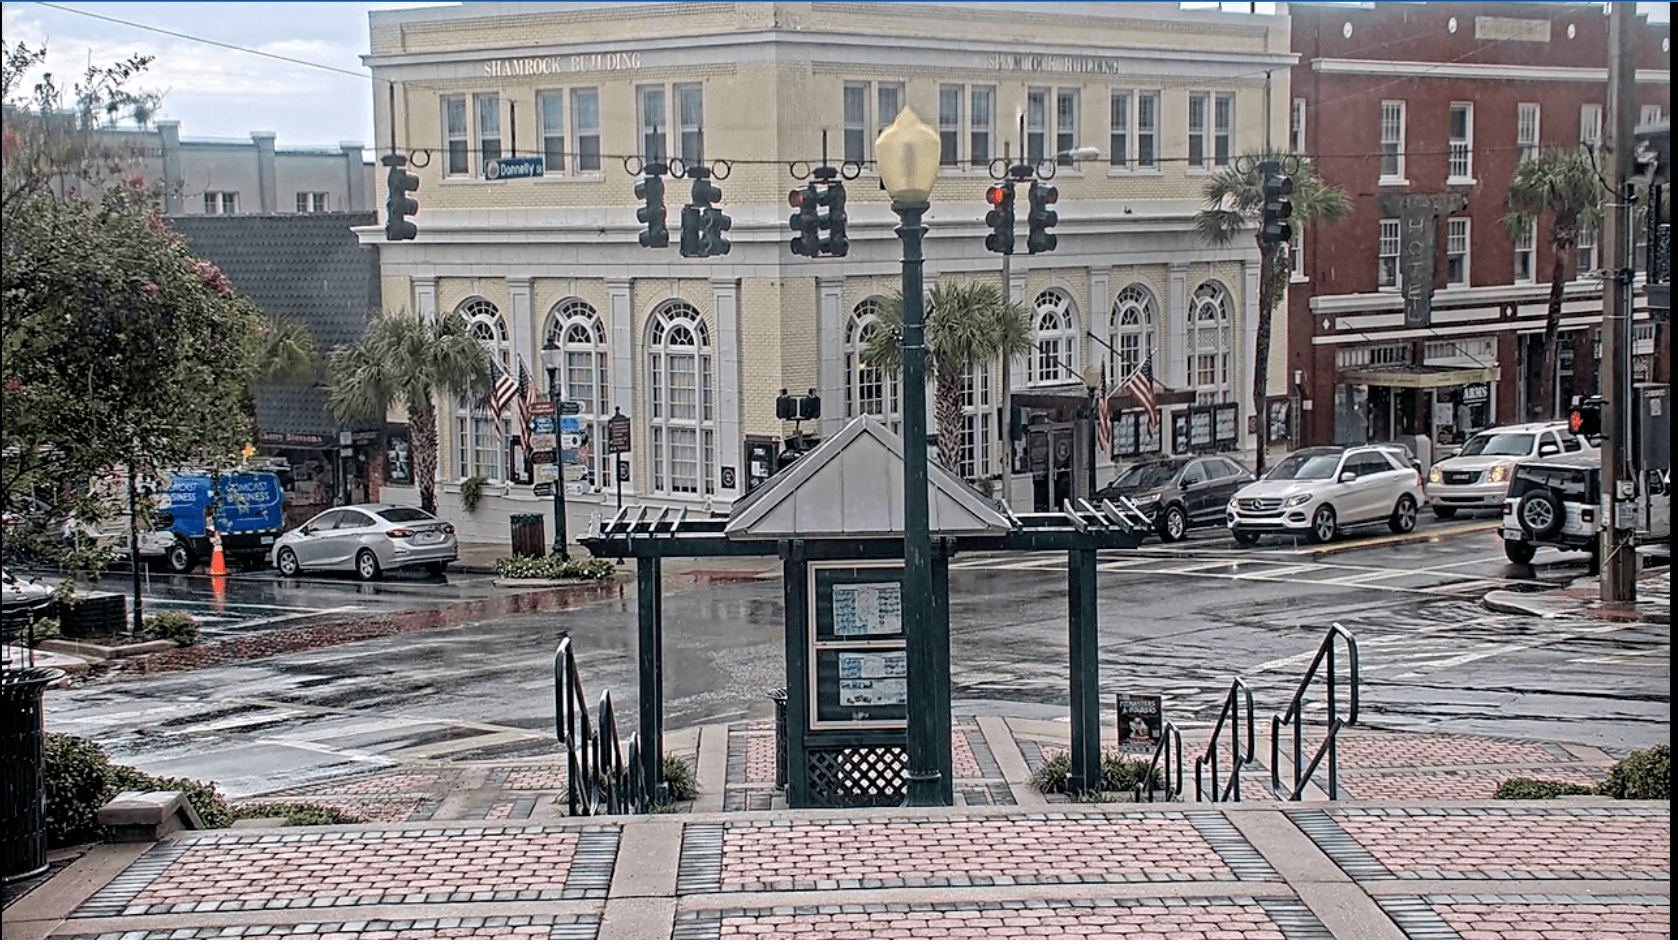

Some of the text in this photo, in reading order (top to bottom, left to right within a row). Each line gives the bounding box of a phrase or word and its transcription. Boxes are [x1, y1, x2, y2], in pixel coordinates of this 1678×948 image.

[485, 53, 641, 77] SHAMROCK BUILDING
[986, 54, 1120, 75] SHAMROCK BUILDING
[500, 161, 535, 178] Donnelly
[1462, 386, 1488, 400] ARMS
